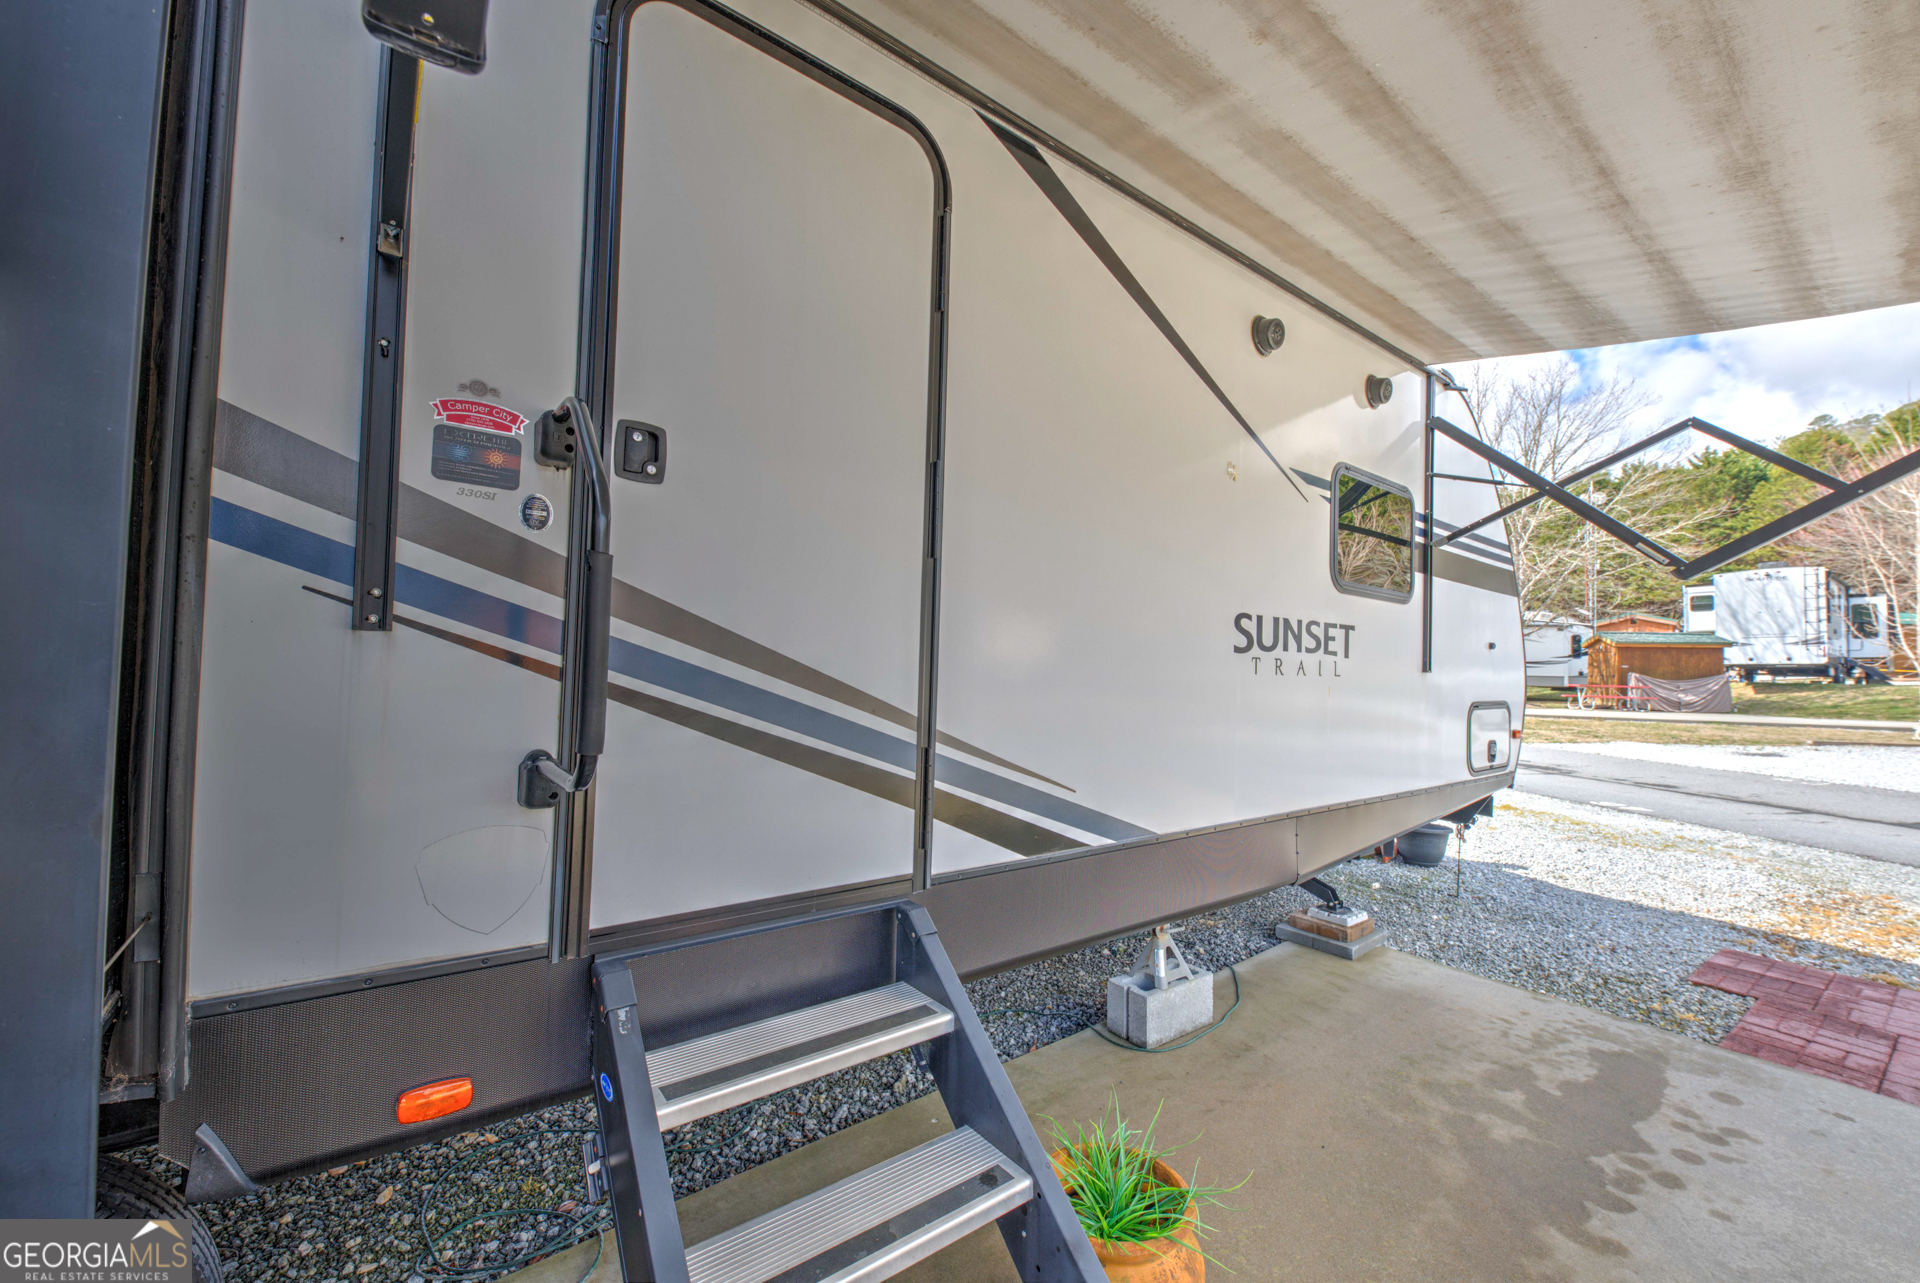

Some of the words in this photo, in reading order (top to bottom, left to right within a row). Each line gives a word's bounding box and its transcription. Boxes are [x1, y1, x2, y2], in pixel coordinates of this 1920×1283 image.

[447, 401, 490, 413] Camper
[492, 408, 513, 422] City
[456, 487, 498, 501] 330SI
[1233, 612, 1356, 659] SUNSET
[1251, 657, 1341, 677] TRAIL
